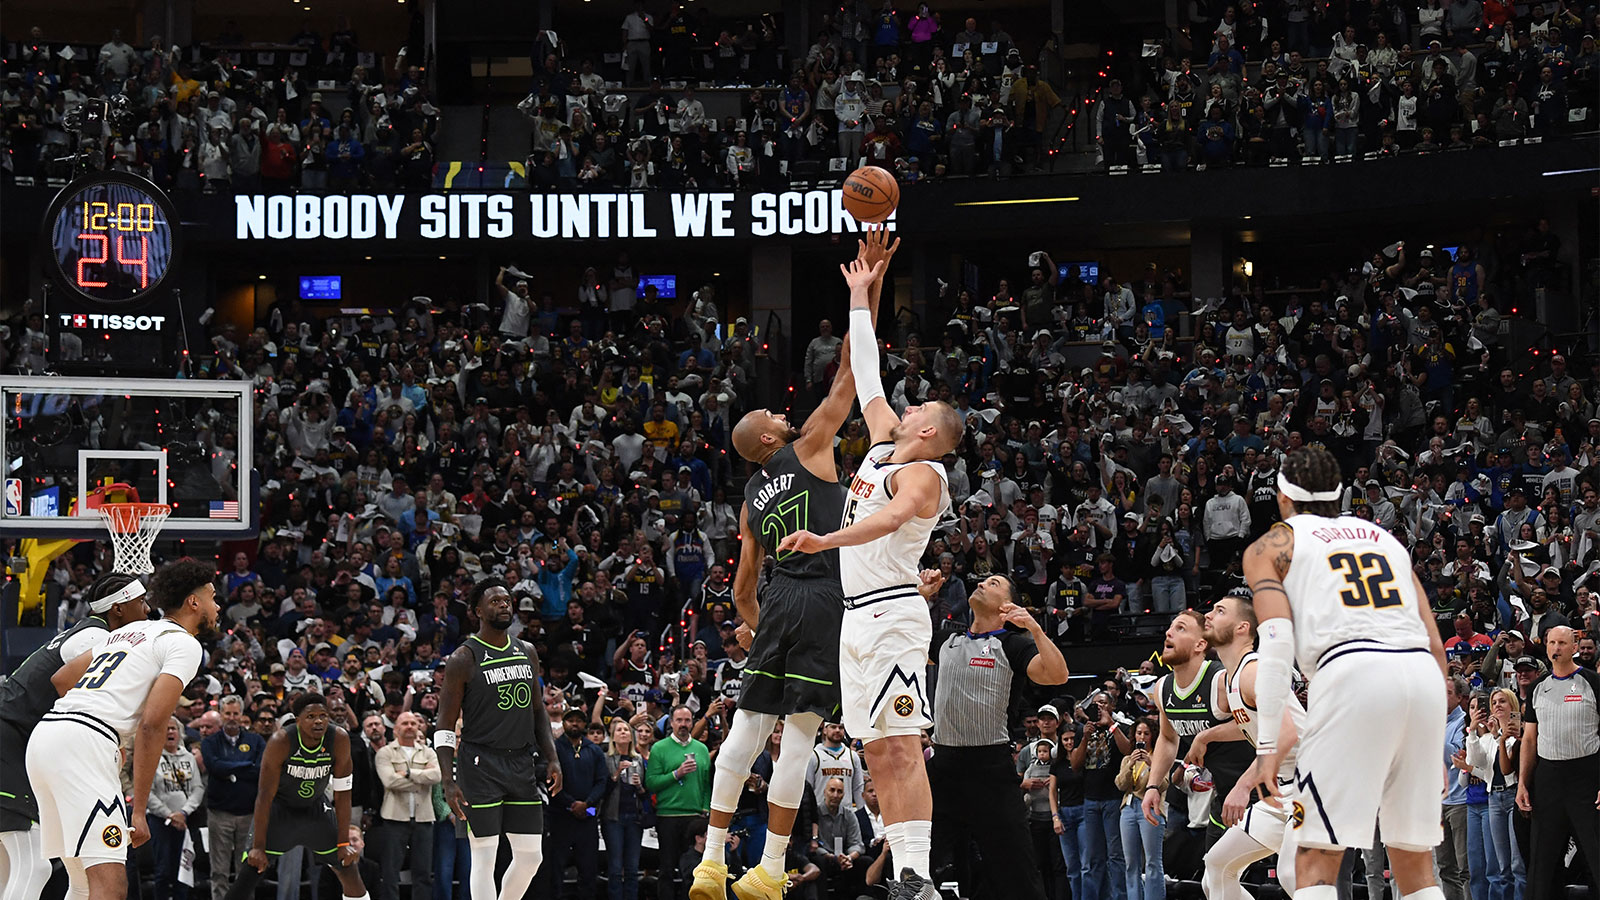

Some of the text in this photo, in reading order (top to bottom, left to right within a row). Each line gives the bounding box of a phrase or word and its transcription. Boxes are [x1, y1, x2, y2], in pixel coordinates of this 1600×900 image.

[82, 201, 154, 232] 12:00
[235, 190, 897, 239] NOBODY SITS UNTIL WE SCOR!
[77, 233, 148, 289] 24
[88, 314, 165, 331] TISSOT
[753, 473, 796, 511] GOBERT
[761, 490, 809, 561] 27
[1311, 527, 1381, 544] GORDON
[1328, 552, 1403, 609] 32
[1065, 596, 1075, 606] 15
[79, 650, 128, 690] 23
[970, 658, 993, 667] Emirates
[482, 665, 532, 685] TIMBERWOLVES
[497, 682, 531, 711] 30
[1169, 718, 1210, 735] MBERWOLVES
[287, 764, 332, 780] TIMBERWOLVES
[821, 767, 853, 777] NUGGETS
[297, 780, 316, 798] 5
